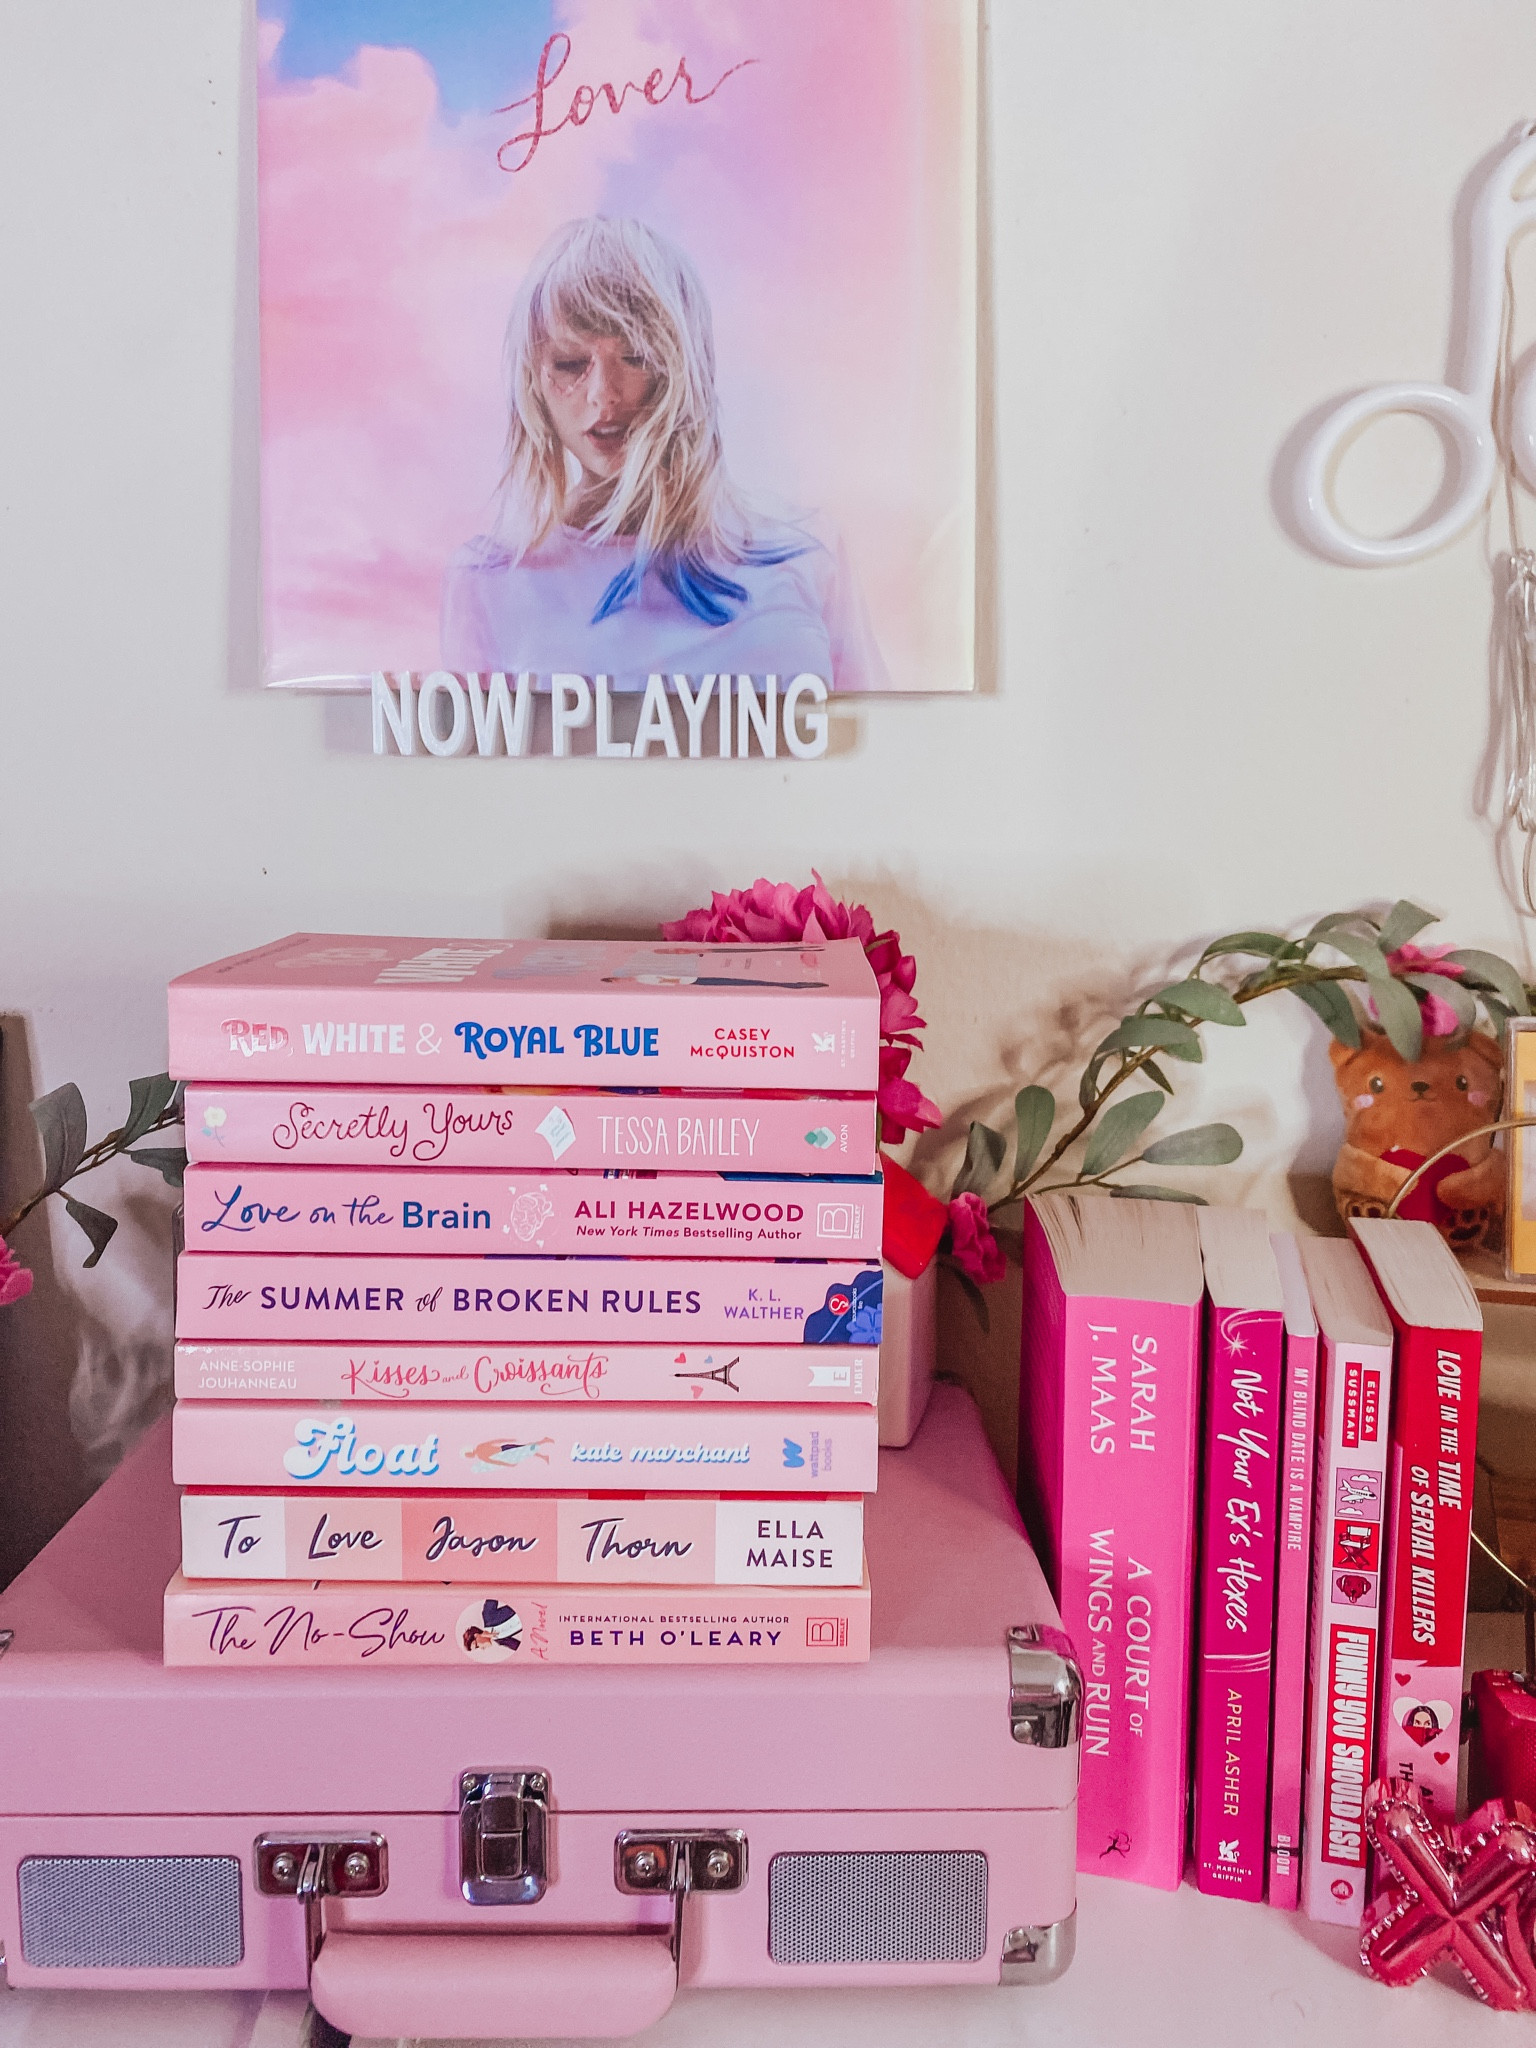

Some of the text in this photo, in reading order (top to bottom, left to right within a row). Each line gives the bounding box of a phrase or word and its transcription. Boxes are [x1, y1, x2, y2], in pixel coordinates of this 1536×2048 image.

[490, 33, 758, 172] Lover
[372, 671, 828, 760] NOW PLAYING
[302, 1021, 405, 1056] WHITE
[415, 1023, 443, 1056] &
[454, 1021, 564, 1060] ROYAL
[574, 1024, 659, 1057] BLUE
[690, 1045, 795, 1060] McQUISTON
[714, 1028, 770, 1041] CASEY
[273, 1102, 513, 1161] Secretly Yours
[597, 1116, 760, 1156] TESSA BAILEY
[840, 1124, 848, 1152] AVON
[201, 1185, 491, 1232] Love on the Brain
[575, 1200, 804, 1223] ALI HAZELWOOD
[576, 1225, 802, 1241] New York Times Bestselling Author
[203, 1285, 701, 1314] The SUMMER of BROKEN RULES
[724, 1306, 804, 1321] WALTHER
[749, 1288, 781, 1302] K. L.
[198, 1377, 297, 1390] JOUHANNEAU
[199, 1360, 296, 1373] ANNE-SOPHIE
[341, 1352, 608, 1399] Kisses and Croissants
[854, 1359, 863, 1395] EMBER
[1087, 1322, 1117, 1454] J. MAAS
[1130, 1334, 1157, 1451] SARAH
[1347, 1369, 1357, 1440] SUSSMAN
[1365, 1381, 1375, 1433] ELISSA
[283, 1417, 440, 1480] Float
[570, 1442, 750, 1463] kate marchant
[1437, 1349, 1461, 1510] LOVE IN THE TIME
[809, 1431, 819, 1478] wattpad
[822, 1438, 832, 1472] books
[1287, 1367, 1308, 1551] MY BLIND DATE IS A VAMPIRE
[1217, 1368, 1270, 1632] Not Your Ex's Hexes
[218, 1515, 261, 1559] To
[308, 1513, 382, 1561] Love
[425, 1516, 537, 1562] Jason
[581, 1517, 693, 1563] Thorn
[757, 1520, 824, 1539] ELLA
[746, 1550, 833, 1568] MAISE
[1410, 1465, 1436, 1646] OF SERIAL KILLERS
[192, 1605, 445, 1657] The No-Show
[559, 1615, 790, 1624] INTERNATIONAL BESTSELLING AUTHOR
[570, 1630, 782, 1646] BETH O'LEARY
[1085, 1529, 1114, 1756] WINGS AND RUIN
[1124, 1556, 1152, 1738] A COURT OF
[1223, 1688, 1242, 1816] APRIL ASHER
[1328, 1630, 1369, 1861] FUNNY YOU SHOULD ASK
